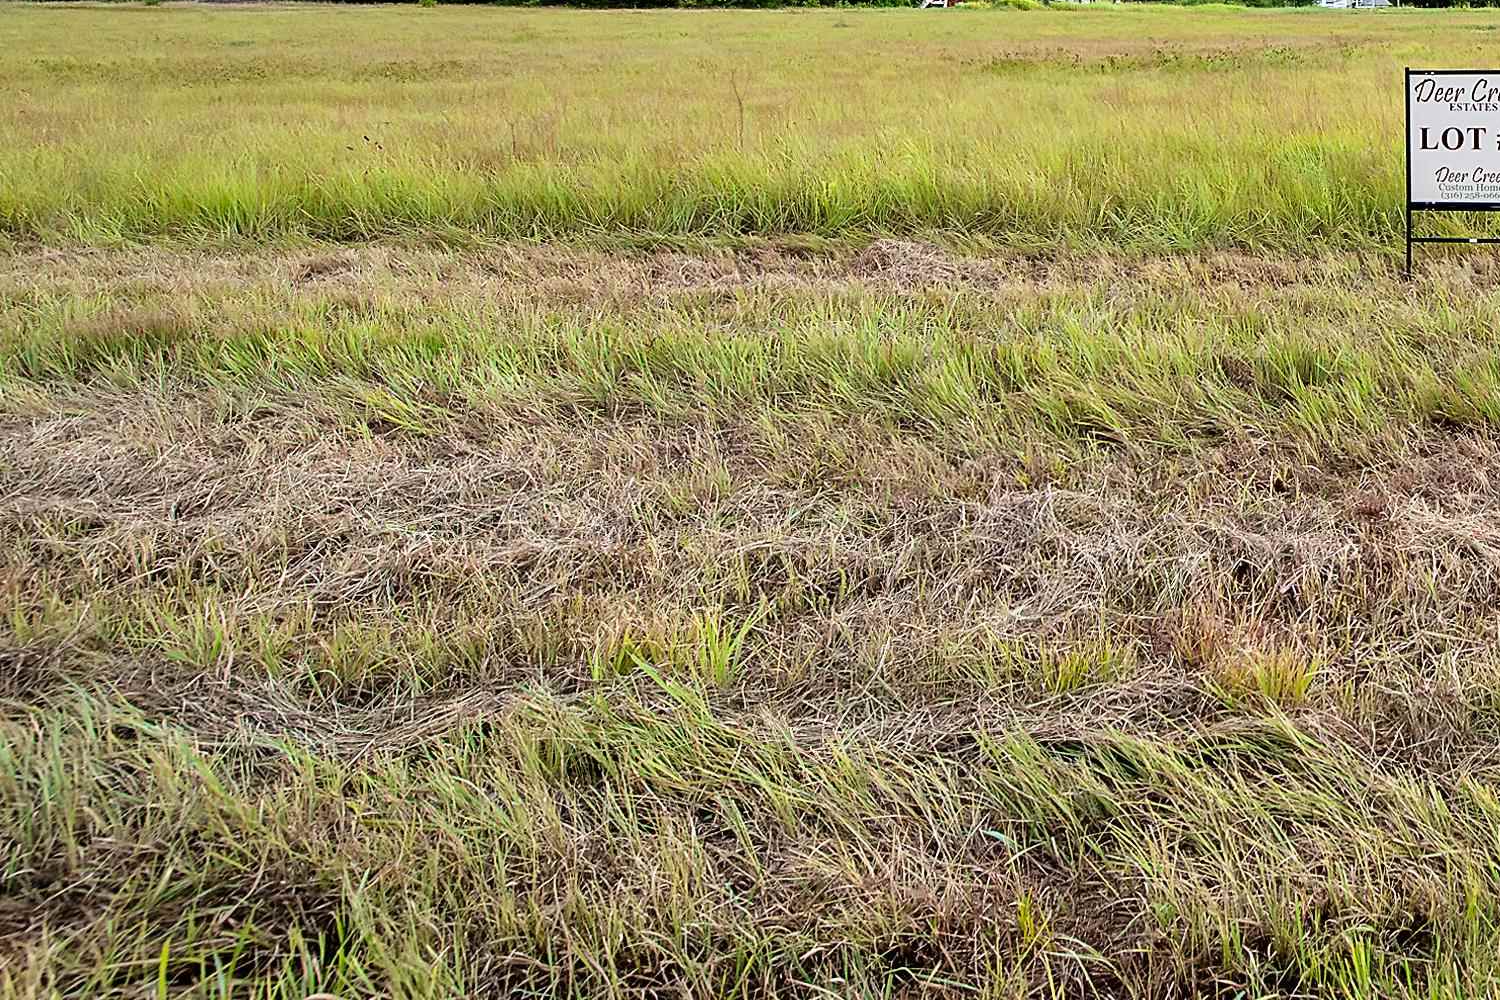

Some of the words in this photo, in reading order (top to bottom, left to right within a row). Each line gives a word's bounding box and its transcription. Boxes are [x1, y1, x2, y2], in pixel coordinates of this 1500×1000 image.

[1415, 79, 1464, 102] Deer
[1420, 128, 1486, 150] LOT
[1435, 167, 1468, 182] Deer
